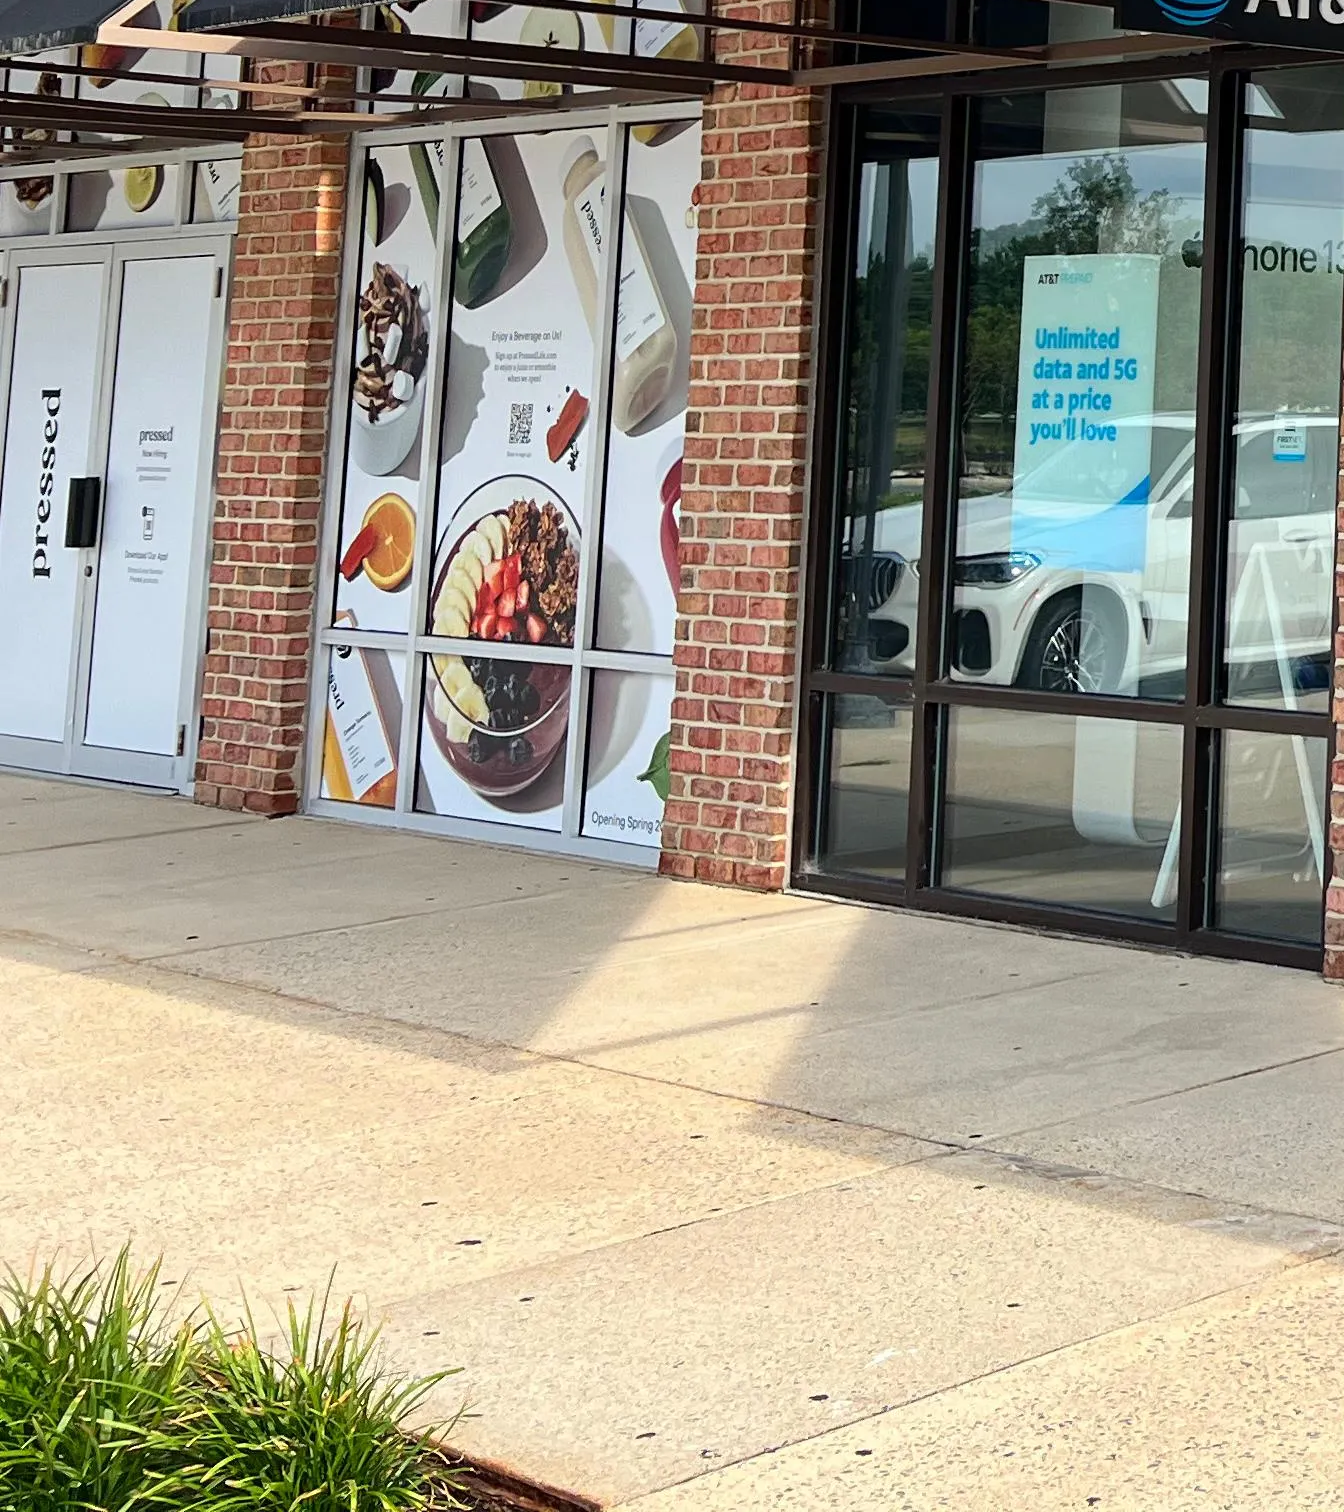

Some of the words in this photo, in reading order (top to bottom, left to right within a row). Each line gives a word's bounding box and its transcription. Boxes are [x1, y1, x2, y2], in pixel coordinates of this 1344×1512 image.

[1038, 273, 1059, 285] AT&T
[492, 330, 508, 343] Enjoy
[514, 331, 542, 343] Beverage
[1035, 326, 1120, 349] Unlimited
[1033, 357, 1072, 380] data
[1077, 357, 1109, 380] and
[1114, 358, 1137, 380] 5G
[1032, 389, 1049, 409] at
[1053, 392, 1063, 409] a
[1068, 387, 1112, 416] price
[139, 426, 174, 445] pressed
[1029, 418, 1076, 445] you'll
[1082, 418, 1117, 441] love
[33, 388, 62, 578] pressed
[591, 811, 626, 830] Opening
[627, 815, 654, 835] Spring
